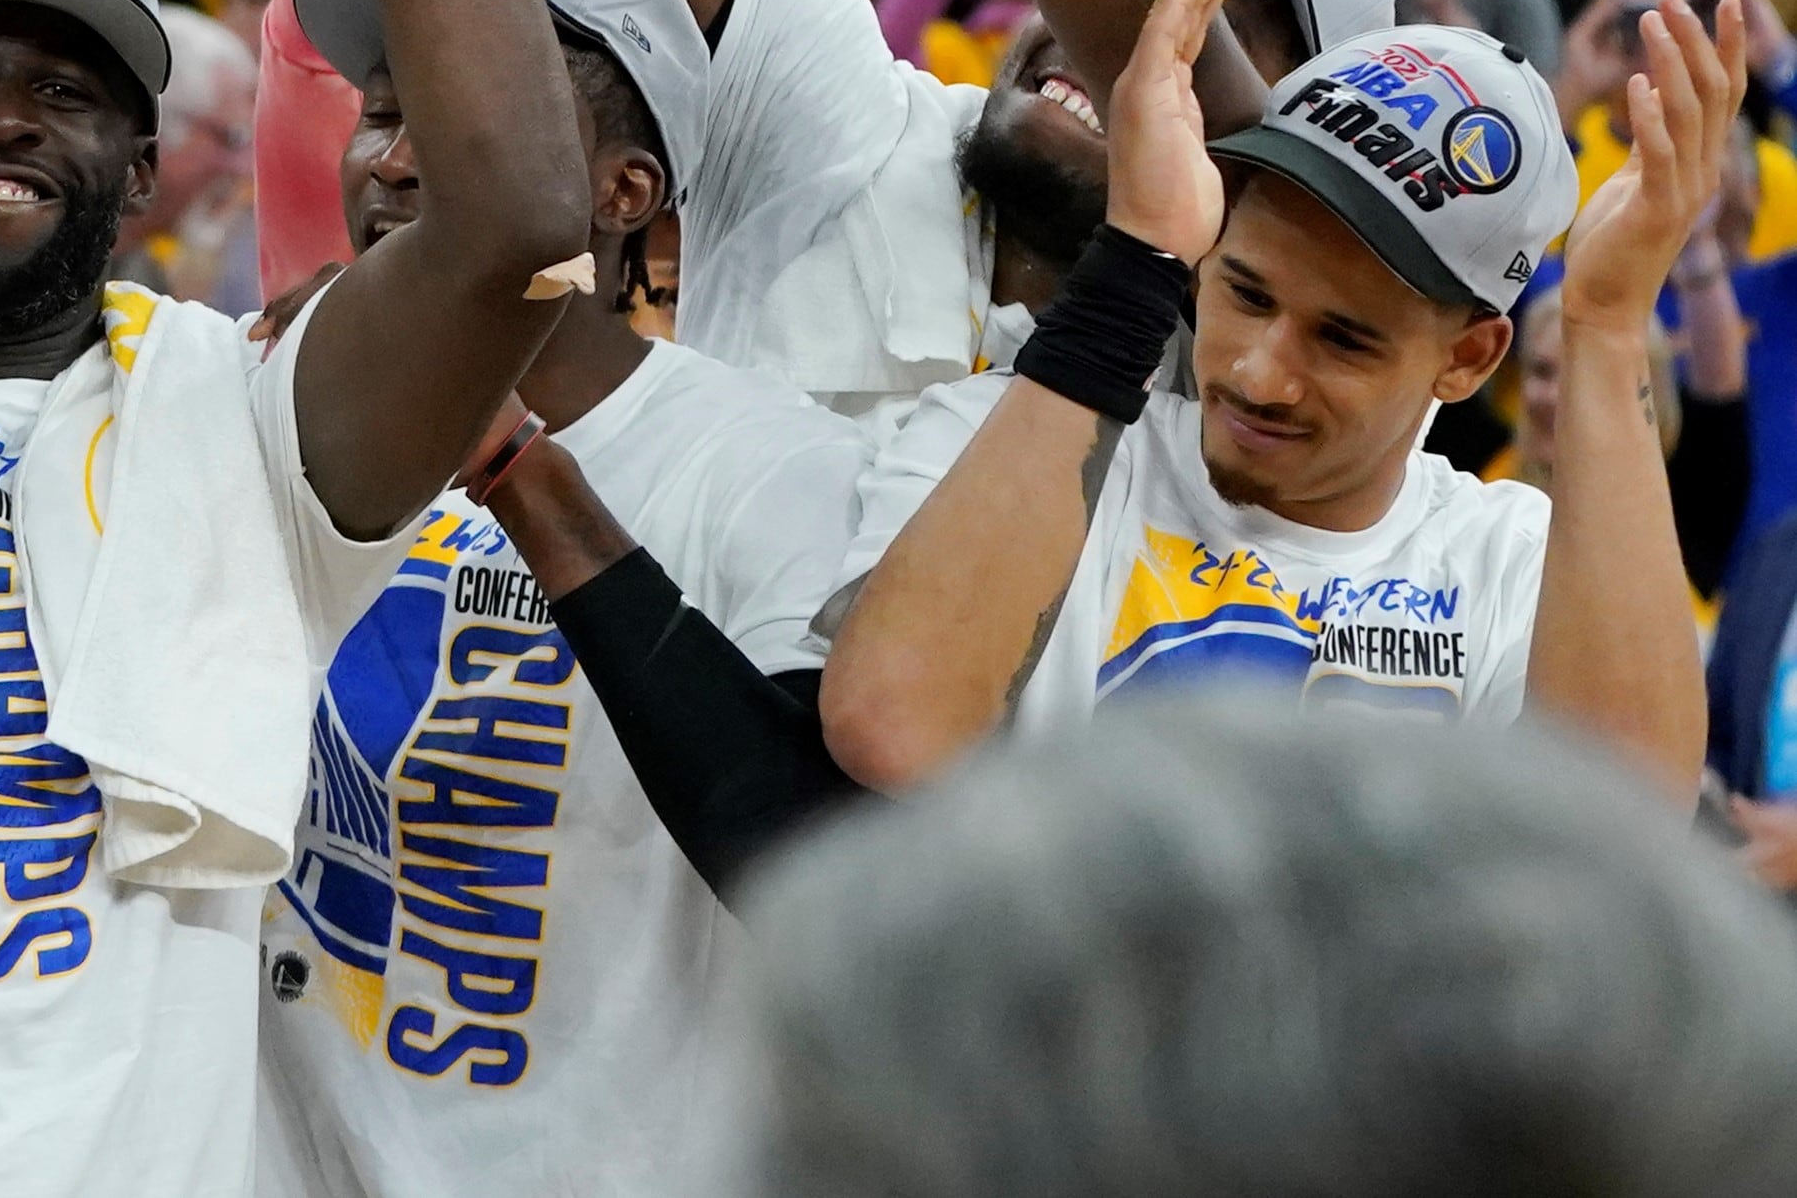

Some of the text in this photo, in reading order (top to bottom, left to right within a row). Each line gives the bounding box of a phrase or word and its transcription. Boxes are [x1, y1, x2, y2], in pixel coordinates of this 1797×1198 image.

[1278, 77, 1460, 213] Finals
[1329, 62, 1439, 131] NBA
[1295, 576, 1460, 625] WESTERN
[383, 625, 577, 1087] CHAMPS
